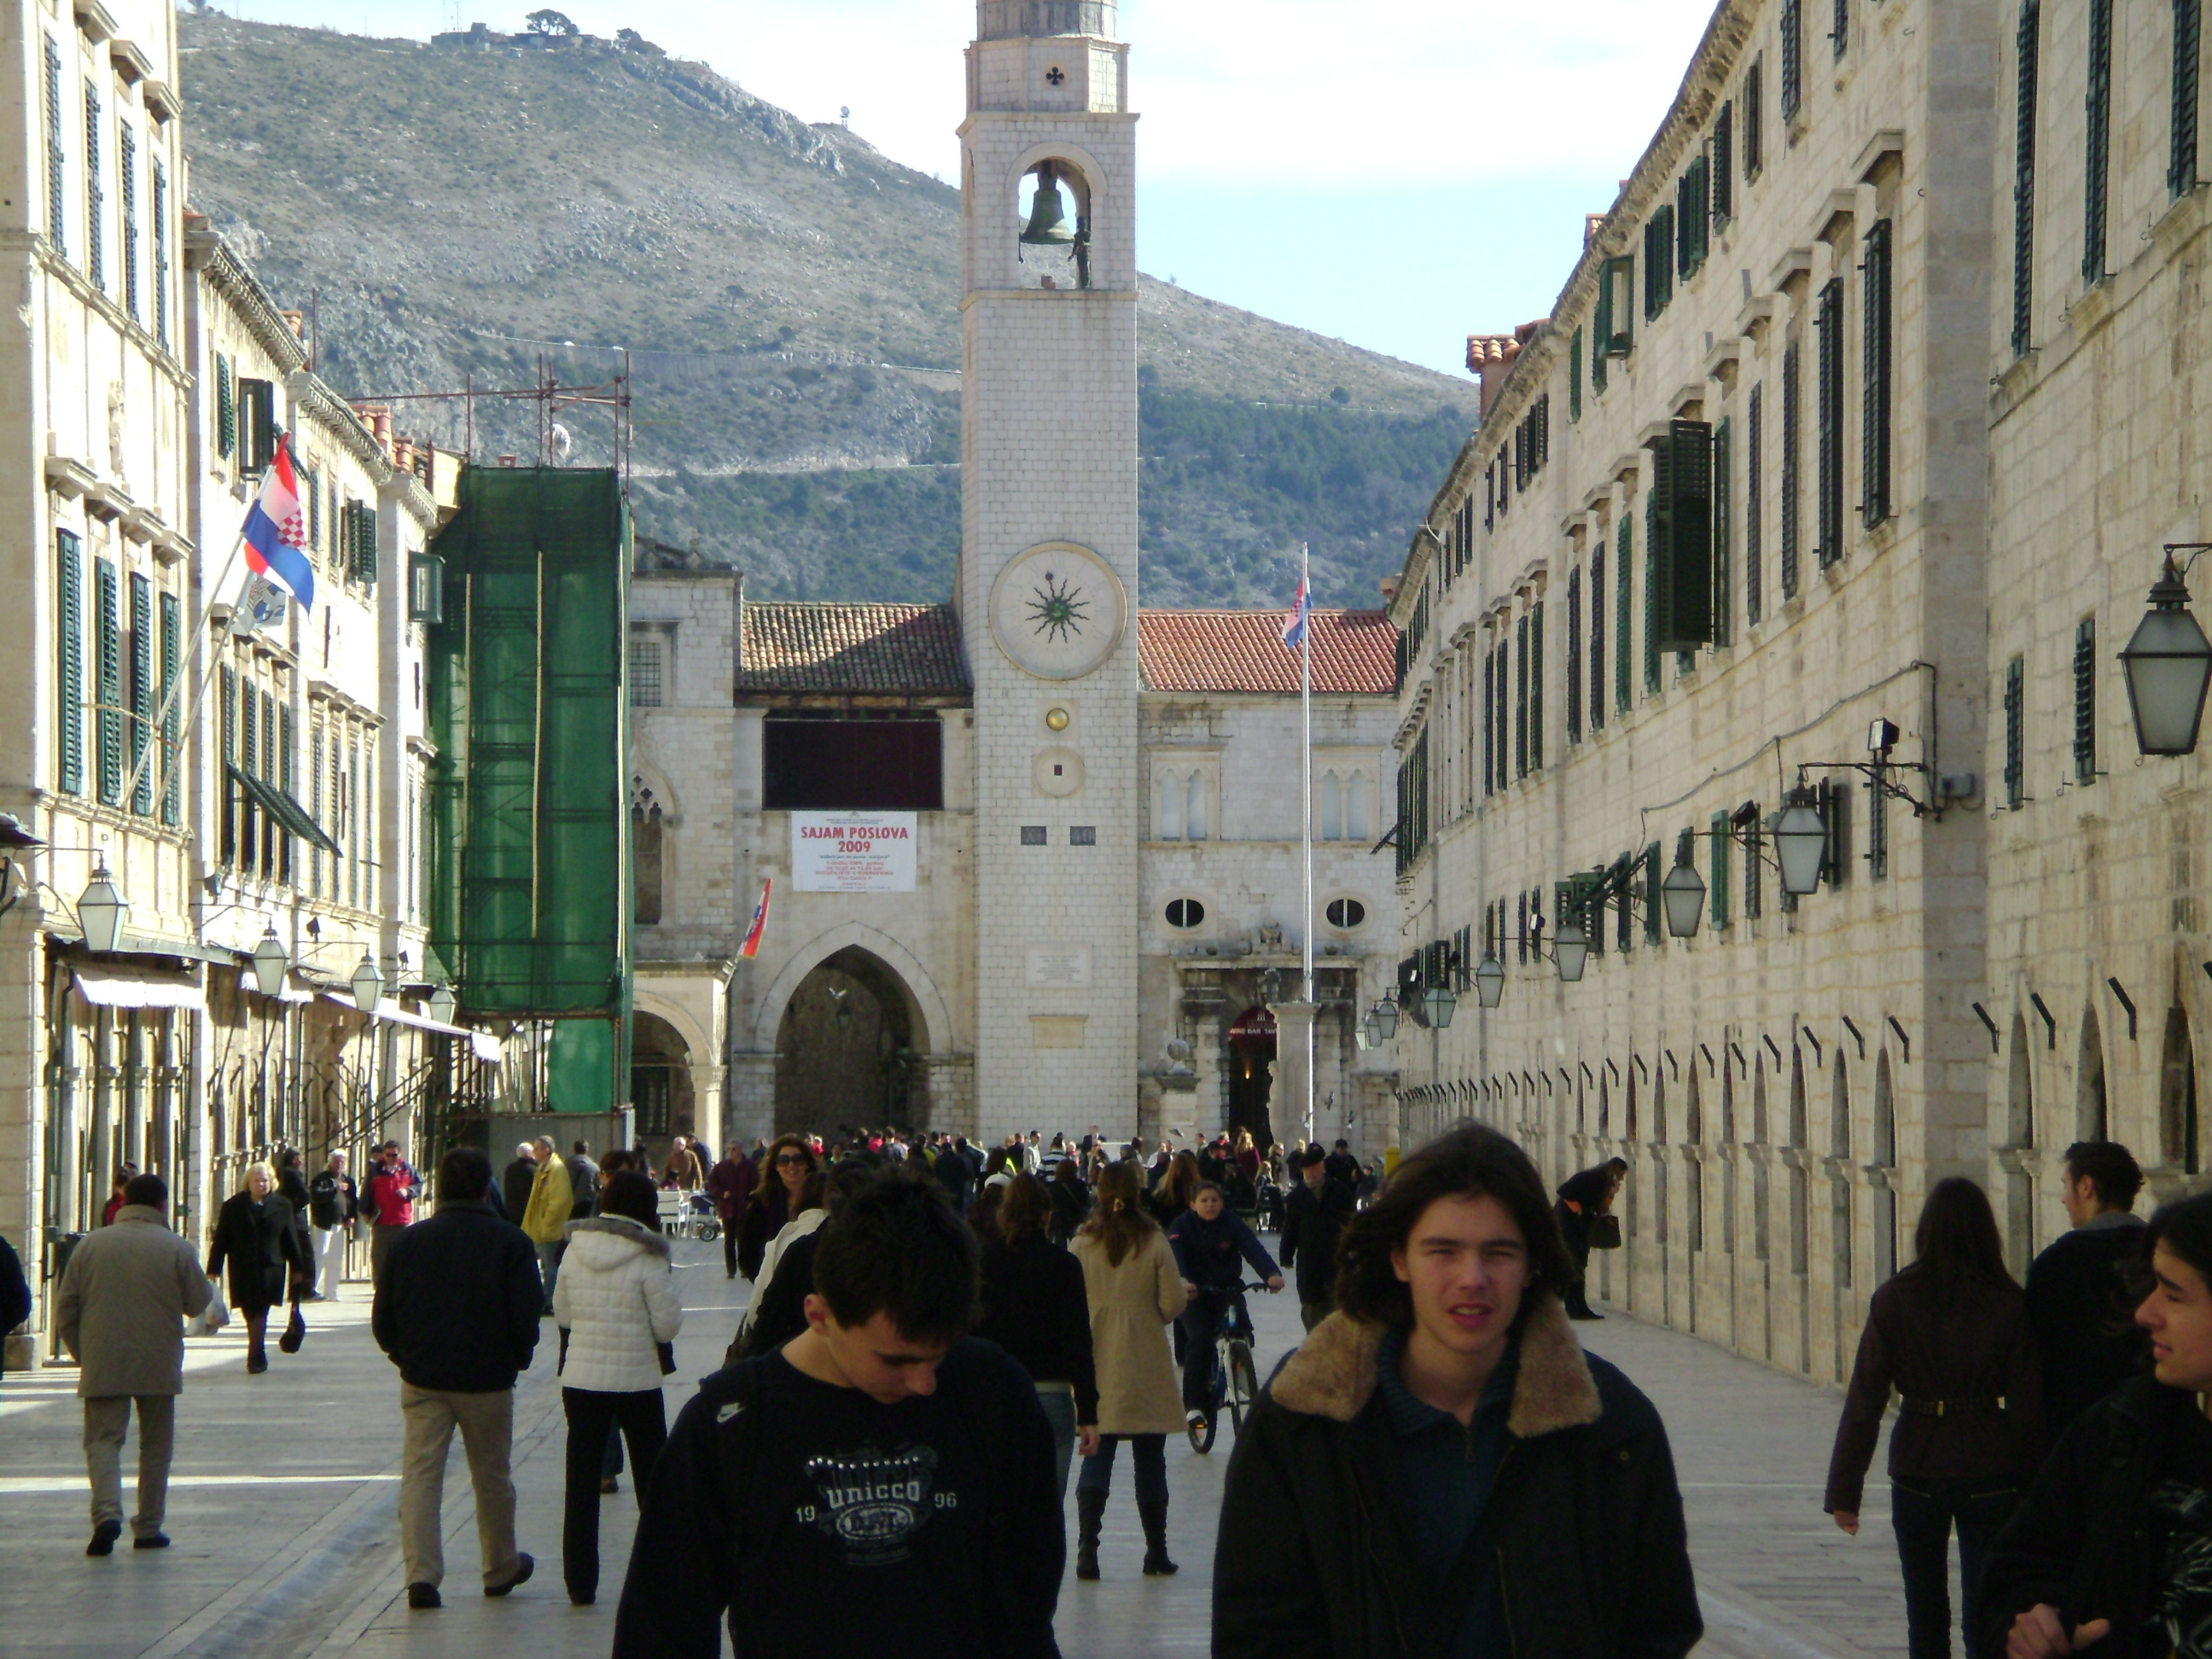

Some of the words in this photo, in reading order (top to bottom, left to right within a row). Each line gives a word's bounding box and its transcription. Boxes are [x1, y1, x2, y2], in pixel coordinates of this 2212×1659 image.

[800, 826, 844, 839] SAJAM
[849, 827, 909, 839] POSLOVA
[838, 841, 870, 853] 2009
[827, 1481, 920, 1509] unicco
[795, 1505, 815, 1523] 19
[934, 1492, 958, 1508] 96
